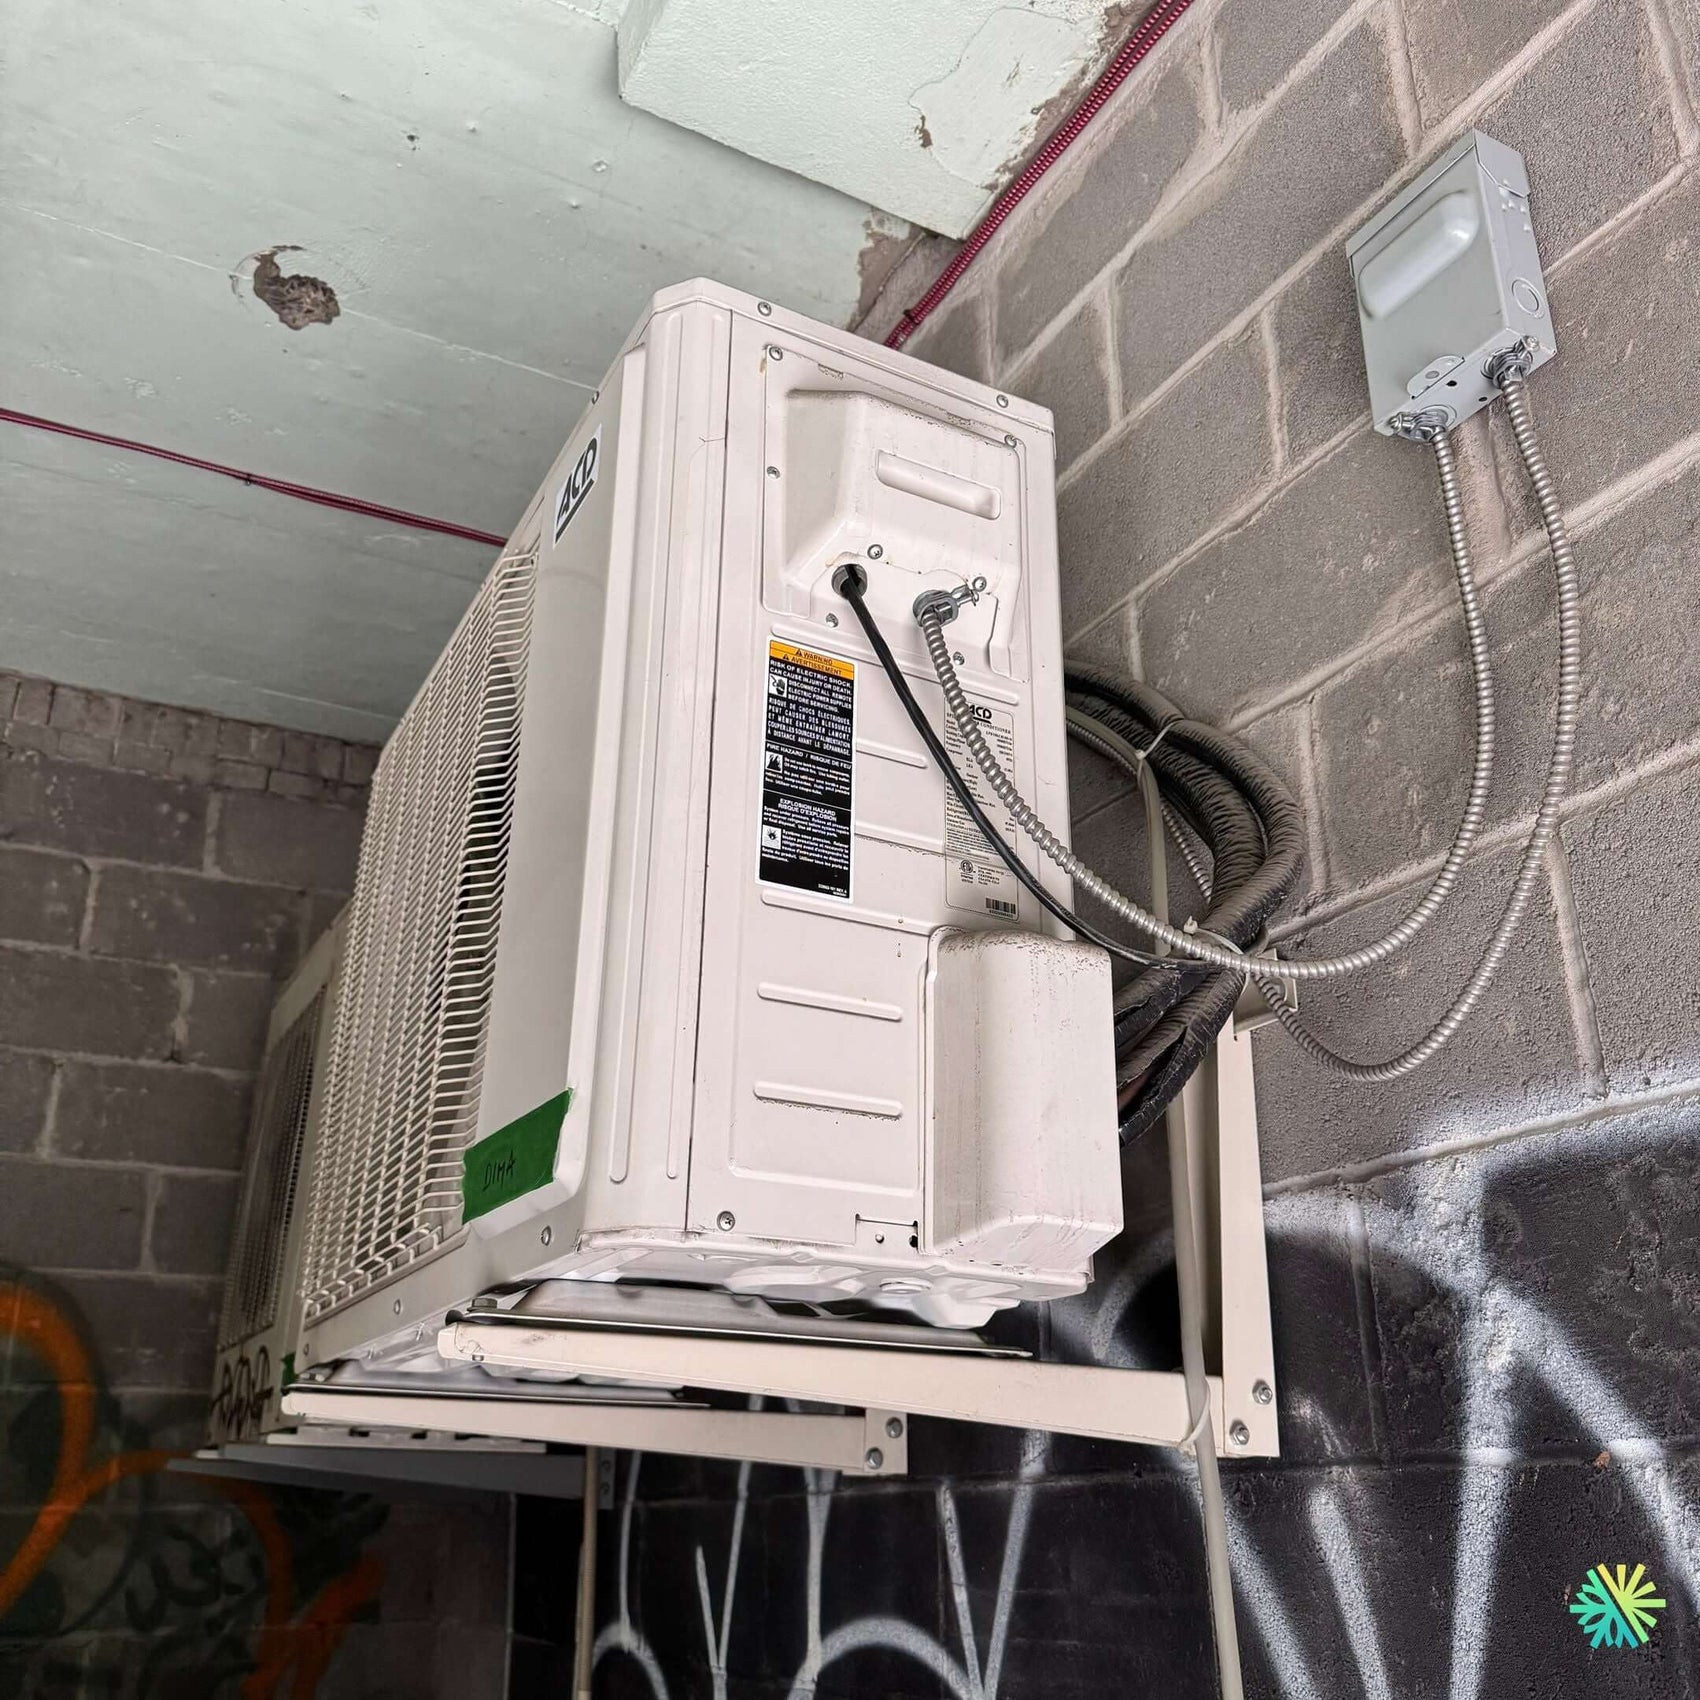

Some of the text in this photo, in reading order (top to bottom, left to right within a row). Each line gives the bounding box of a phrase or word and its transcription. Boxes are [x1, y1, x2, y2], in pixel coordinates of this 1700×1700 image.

[557, 437, 597, 528] ACD
[791, 657, 841, 676] AVERTISSEMENT
[803, 652, 832, 664] WARNING
[770, 660, 785, 669] RISK
[797, 668, 827, 681] ELECTRIC
[783, 671, 802, 681] CAUSE
[803, 676, 823, 687] INJURY
[788, 680, 820, 692] DISCONNECT
[832, 692, 851, 702] REMOTE
[788, 687, 852, 709] ELECTRIC POWER SUPPLIES
[788, 694, 809, 704] BEFORE
[769, 698, 786, 708] RISQUE
[799, 706, 815, 715] CHOCS
[769, 705, 782, 713] PEUT
[785, 710, 805, 720] CAUSER
[822, 720, 851, 733] BLESSURES
[774, 730, 795, 741] DISTANCE
[798, 737, 812, 745] AVANT
[781, 747, 803, 757] HAZARD
[810, 754, 830, 764] RISQUE
[778, 803, 799, 812] RISQUE
[800, 809, 836, 821] D'EXPLOSION
[780, 799, 812, 810] EXPLOSION
[813, 806, 836, 816] HAZARD
